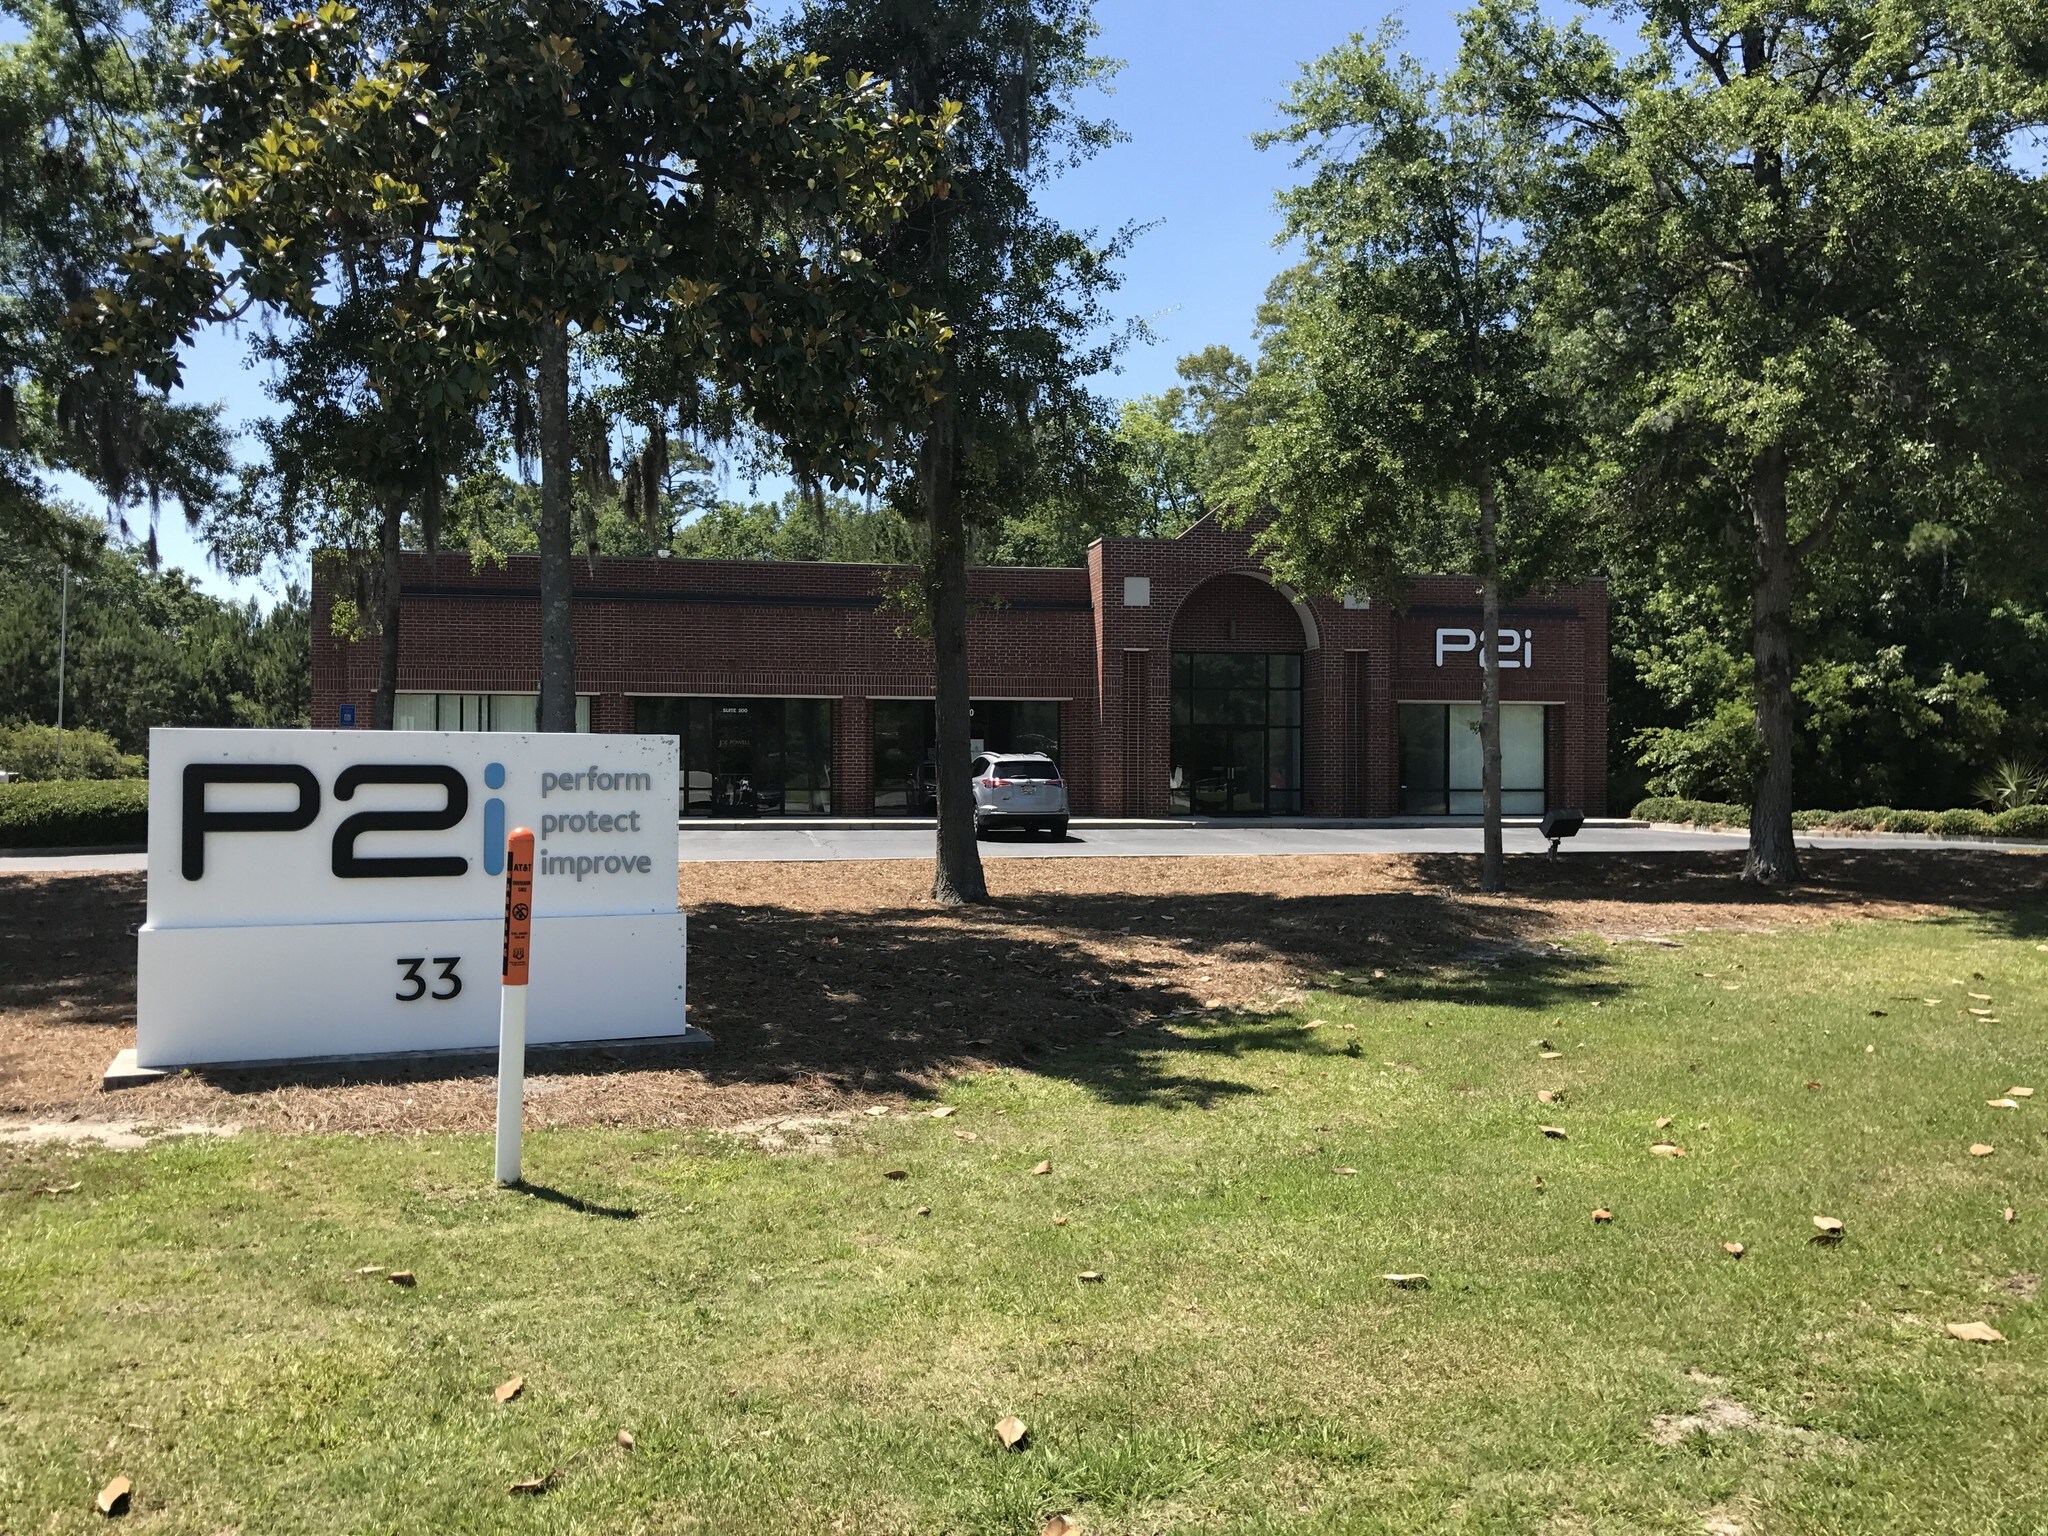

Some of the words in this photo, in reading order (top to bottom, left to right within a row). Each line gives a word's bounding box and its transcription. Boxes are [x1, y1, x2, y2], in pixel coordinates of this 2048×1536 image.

[1436, 628, 1531, 668] P2i
[541, 766, 651, 798] perform
[181, 762, 505, 881] P2i
[541, 810, 641, 840] protect
[513, 863, 532, 872] AT&T
[541, 849, 652, 882] improve
[396, 956, 463, 1002] 33
